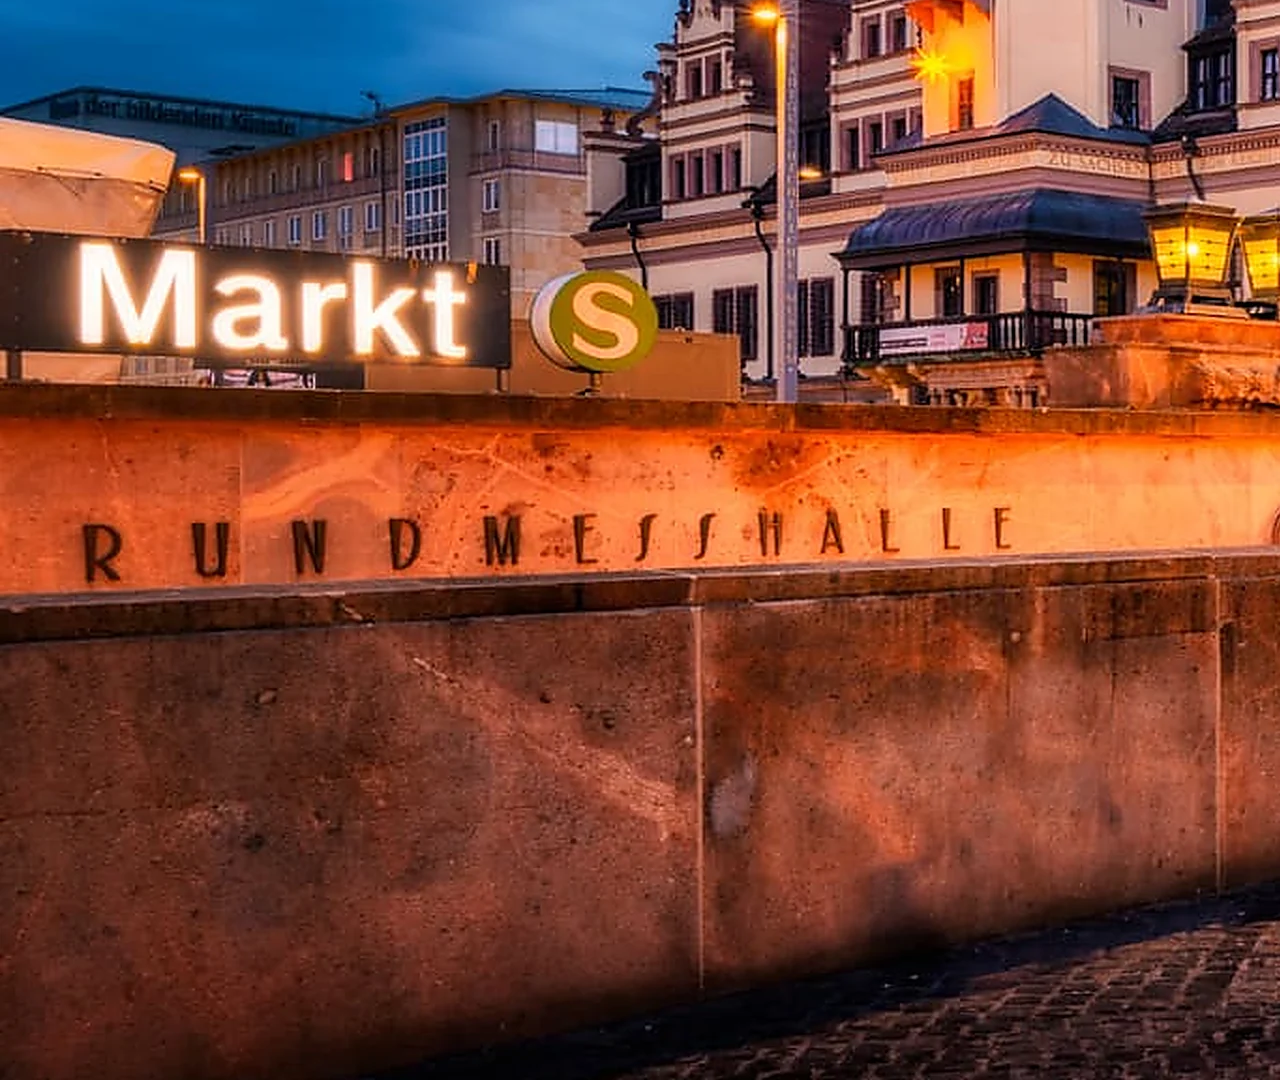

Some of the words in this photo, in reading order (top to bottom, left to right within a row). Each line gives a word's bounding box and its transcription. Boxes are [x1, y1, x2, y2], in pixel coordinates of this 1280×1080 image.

[79, 242, 469, 358] Markt
[571, 282, 640, 359] S
[82, 506, 1012, 585] RUNDMESSHALLE
